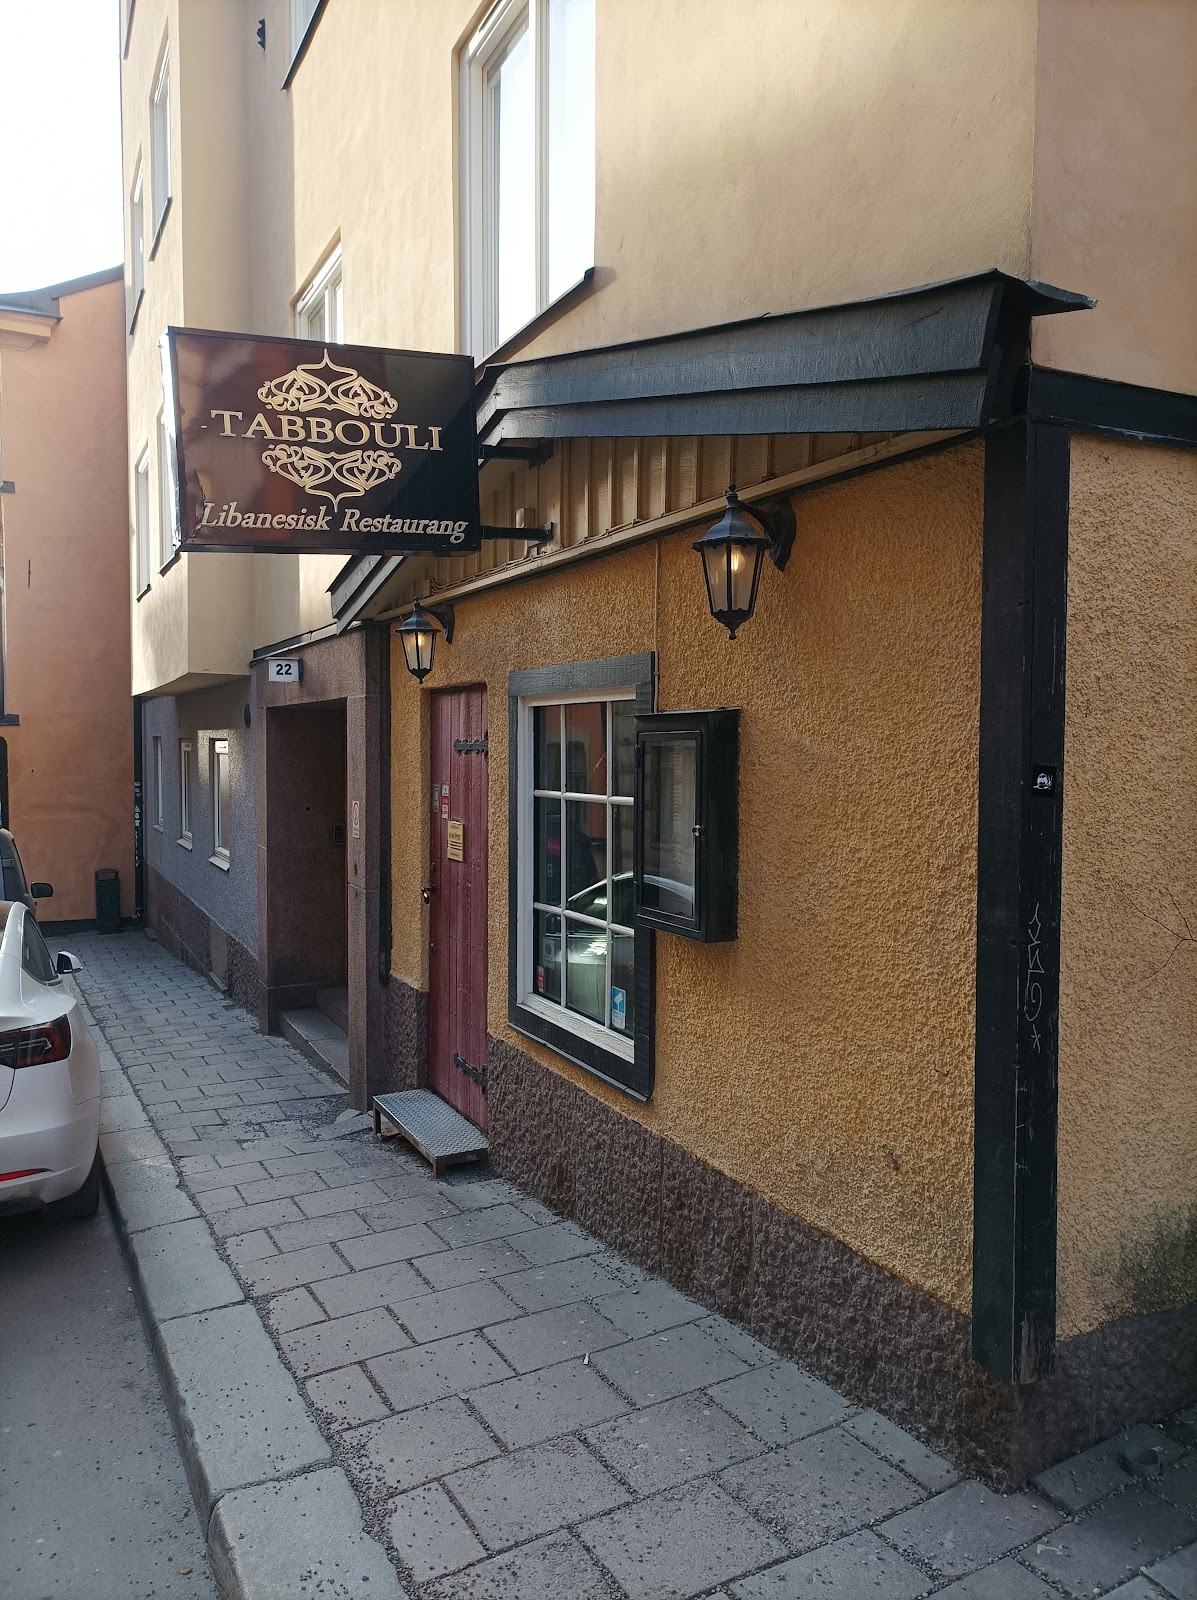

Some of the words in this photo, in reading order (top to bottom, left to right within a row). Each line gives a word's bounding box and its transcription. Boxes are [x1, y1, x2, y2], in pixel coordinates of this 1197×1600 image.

[210, 409, 444, 451] TABBOULI
[200, 502, 332, 532] Libanesisk
[340, 509, 469, 543] Restaurang
[275, 663, 293, 676] 22
